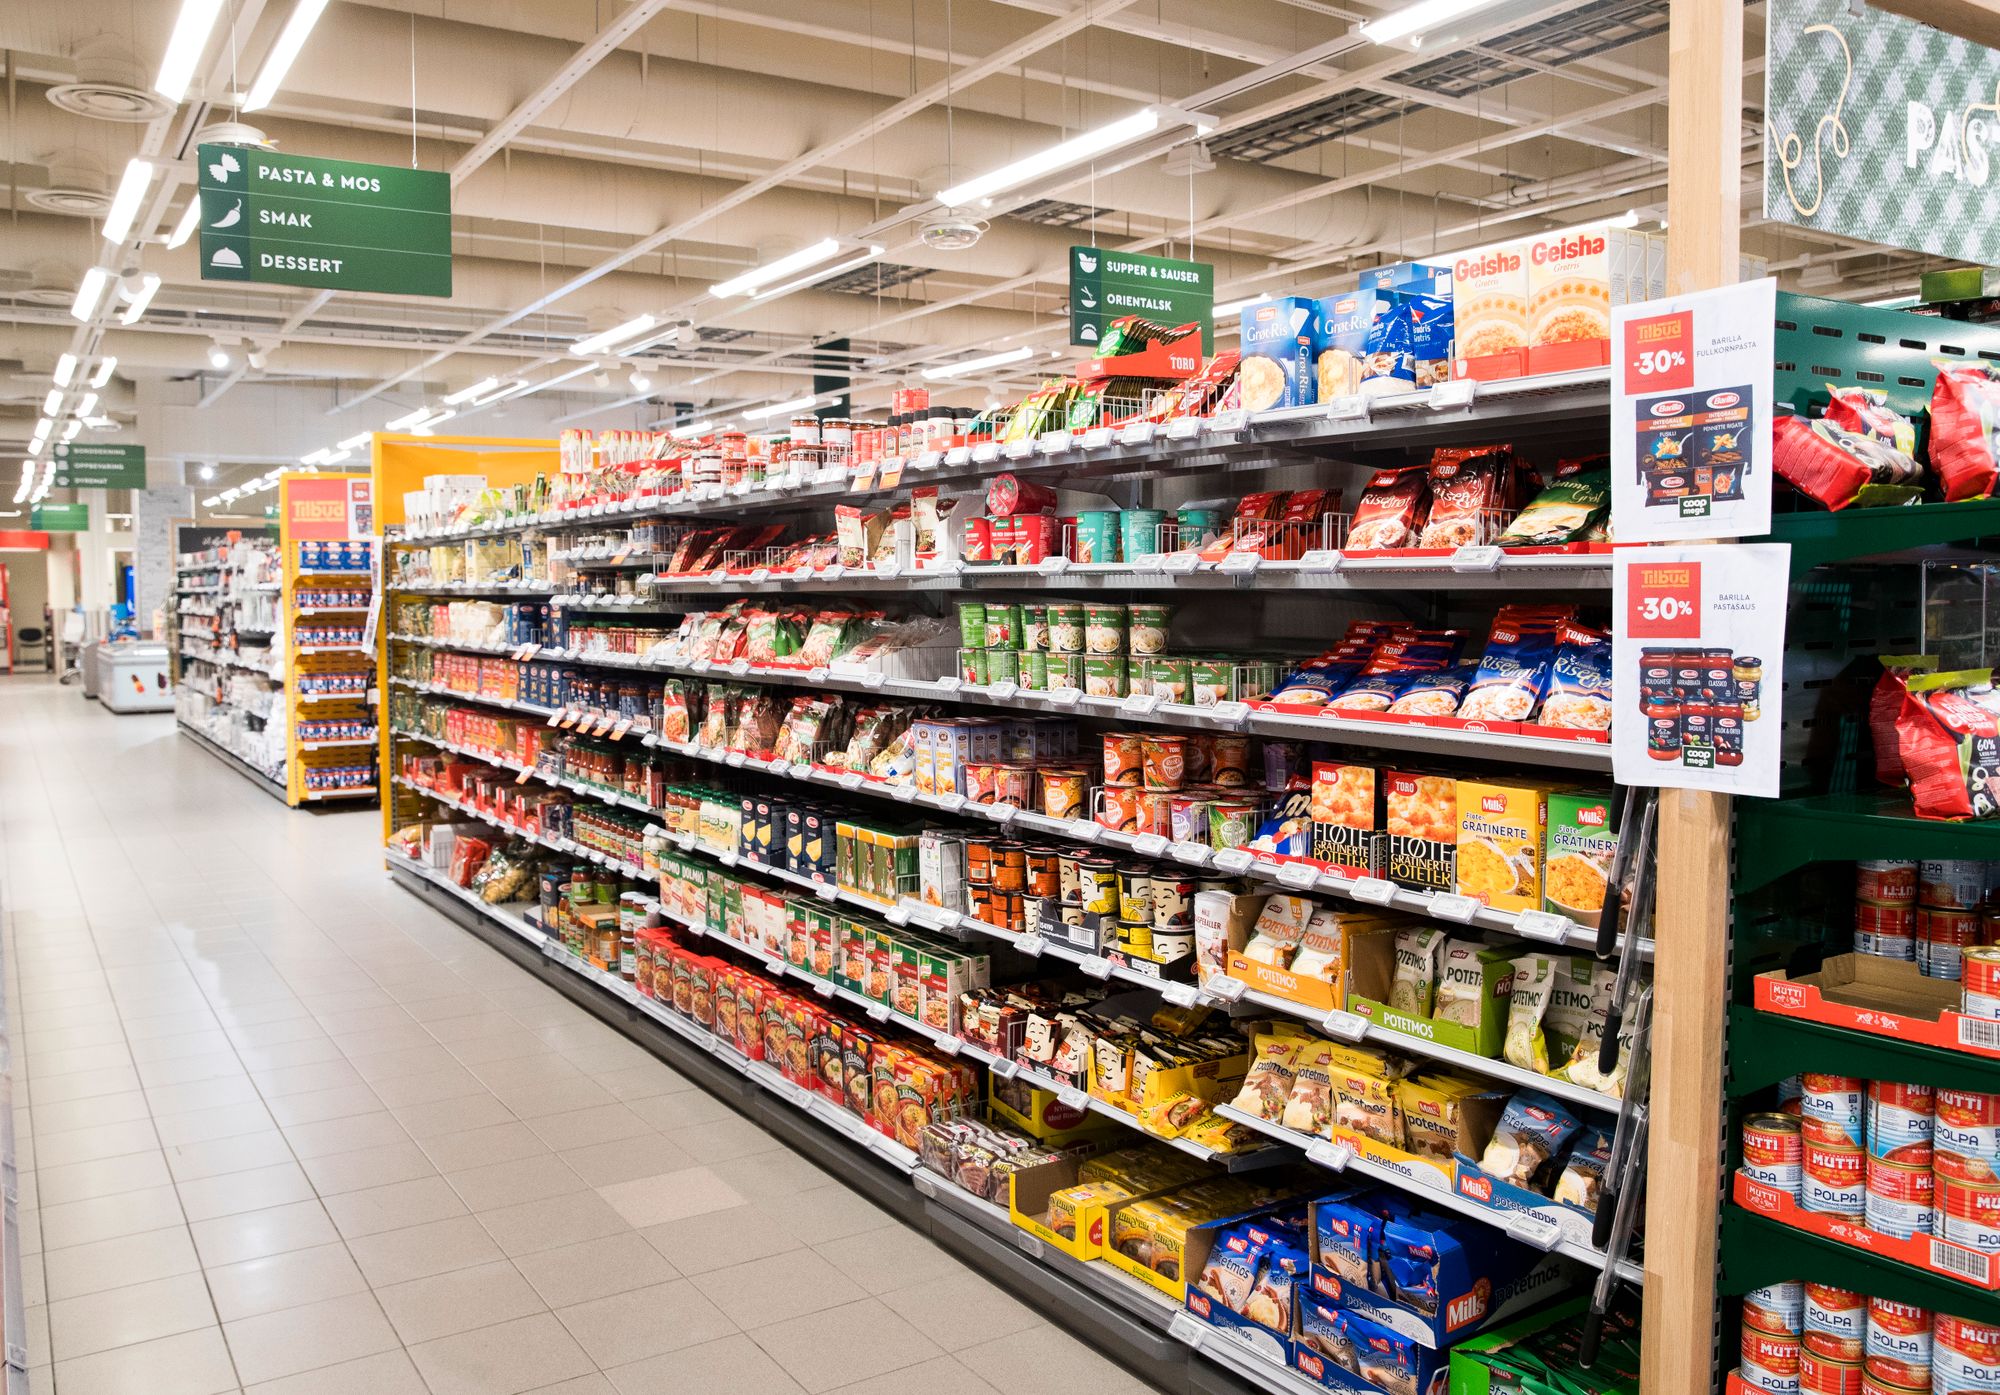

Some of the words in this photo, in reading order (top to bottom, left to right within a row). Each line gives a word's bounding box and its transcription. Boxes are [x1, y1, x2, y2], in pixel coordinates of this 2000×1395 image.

[258, 165, 317, 186] PASTA
[322, 173, 334, 188] &
[341, 175, 381, 192] MOS
[259, 209, 312, 228] SMAK
[1531, 234, 1605, 266] Geisha
[261, 254, 343, 274] DESSERT
[1107, 261, 1148, 276] SUPPER
[1150, 267, 1158, 278] &
[1160, 267, 1199, 283] SAUSER
[1455, 249, 1521, 282] Geisha
[1107, 294, 1172, 311] ORIENTALSK
[1637, 320, 1682, 340] Tilbud
[1696, 341, 1757, 358] FULLKORNPASTA
[1711, 335, 1742, 346] BARILLA
[1170, 356, 1195, 371] TORO
[1633, 349, 1686, 375] -30%
[291, 501, 345, 522] Tilbud
[1683, 499, 1707, 507] coop
[1683, 508, 1705, 516] mega
[1641, 570, 1690, 588] Tilbud
[1637, 597, 1693, 620] -30%
[1714, 603, 1756, 611] PASTASAUS
[1493, 631, 1517, 643] TORO
[1687, 750, 1711, 758] coop
[1687, 758, 1708, 766] mega
[1319, 770, 1336, 782] TORO
[1395, 781, 1415, 793] TORO
[1482, 797, 1504, 812] Mills
[1578, 811, 1603, 824] Mills
[1313, 822, 1369, 849] FLØTE
[1462, 820, 1527, 839] GRATINERTE
[1313, 847, 1368, 869] POTETER
[1314, 839, 1369, 859] GRATINERTE
[1391, 834, 1452, 862] FLØTE
[1391, 854, 1452, 872] GRATINERTE
[1390, 862, 1451, 886] POTETER
[1259, 915, 1301, 941] POTETMOS
[1397, 949, 1427, 972] OTETMOS
[1257, 966, 1298, 990] POTETMOS
[1446, 967, 1482, 987] POTET
[1773, 985, 1802, 998] MUTTI
[1383, 1011, 1434, 1039] POTETMOS
[845, 1052, 866, 1069] LASAGNE
[899, 1091, 923, 1104] LASAGNE
[1420, 1103, 1438, 1116] Mills
[1407, 1115, 1457, 1139] potetmo
[1503, 1113, 1550, 1148] otetstappe
[1936, 1125, 1979, 1146] POLPA
[1366, 1152, 1413, 1177] potetmos
[1812, 1152, 1860, 1170] MUTTI
[1462, 1178, 1489, 1201] Mills
[1749, 1186, 1777, 1201] MUTTI
[1814, 1188, 1857, 1203] POLPA
[1494, 1194, 1557, 1226] potetstappe
[1250, 1230, 1265, 1245] Mills
[1333, 1221, 1349, 1235] Mills
[1228, 1238, 1244, 1253] Mills
[1319, 1234, 1361, 1266] potetmos
[1315, 1277, 1339, 1299] Mills
[1190, 1296, 1210, 1315] Mills
[1346, 1293, 1393, 1324] potetmos
[1449, 1295, 1485, 1328] Mills
[1873, 1296, 1921, 1318] MUTTI
[1214, 1312, 1253, 1341] potetmos
[1809, 1307, 1852, 1327] POLPA
[1873, 1331, 1919, 1352] POLPA
[1961, 1326, 2000, 1345] MUT
[1760, 1342, 1800, 1358] MUTT
[1299, 1354, 1323, 1378] Mills
[1963, 1366, 2000, 1380] POLP
[1762, 1377, 1799, 1390] POLP
